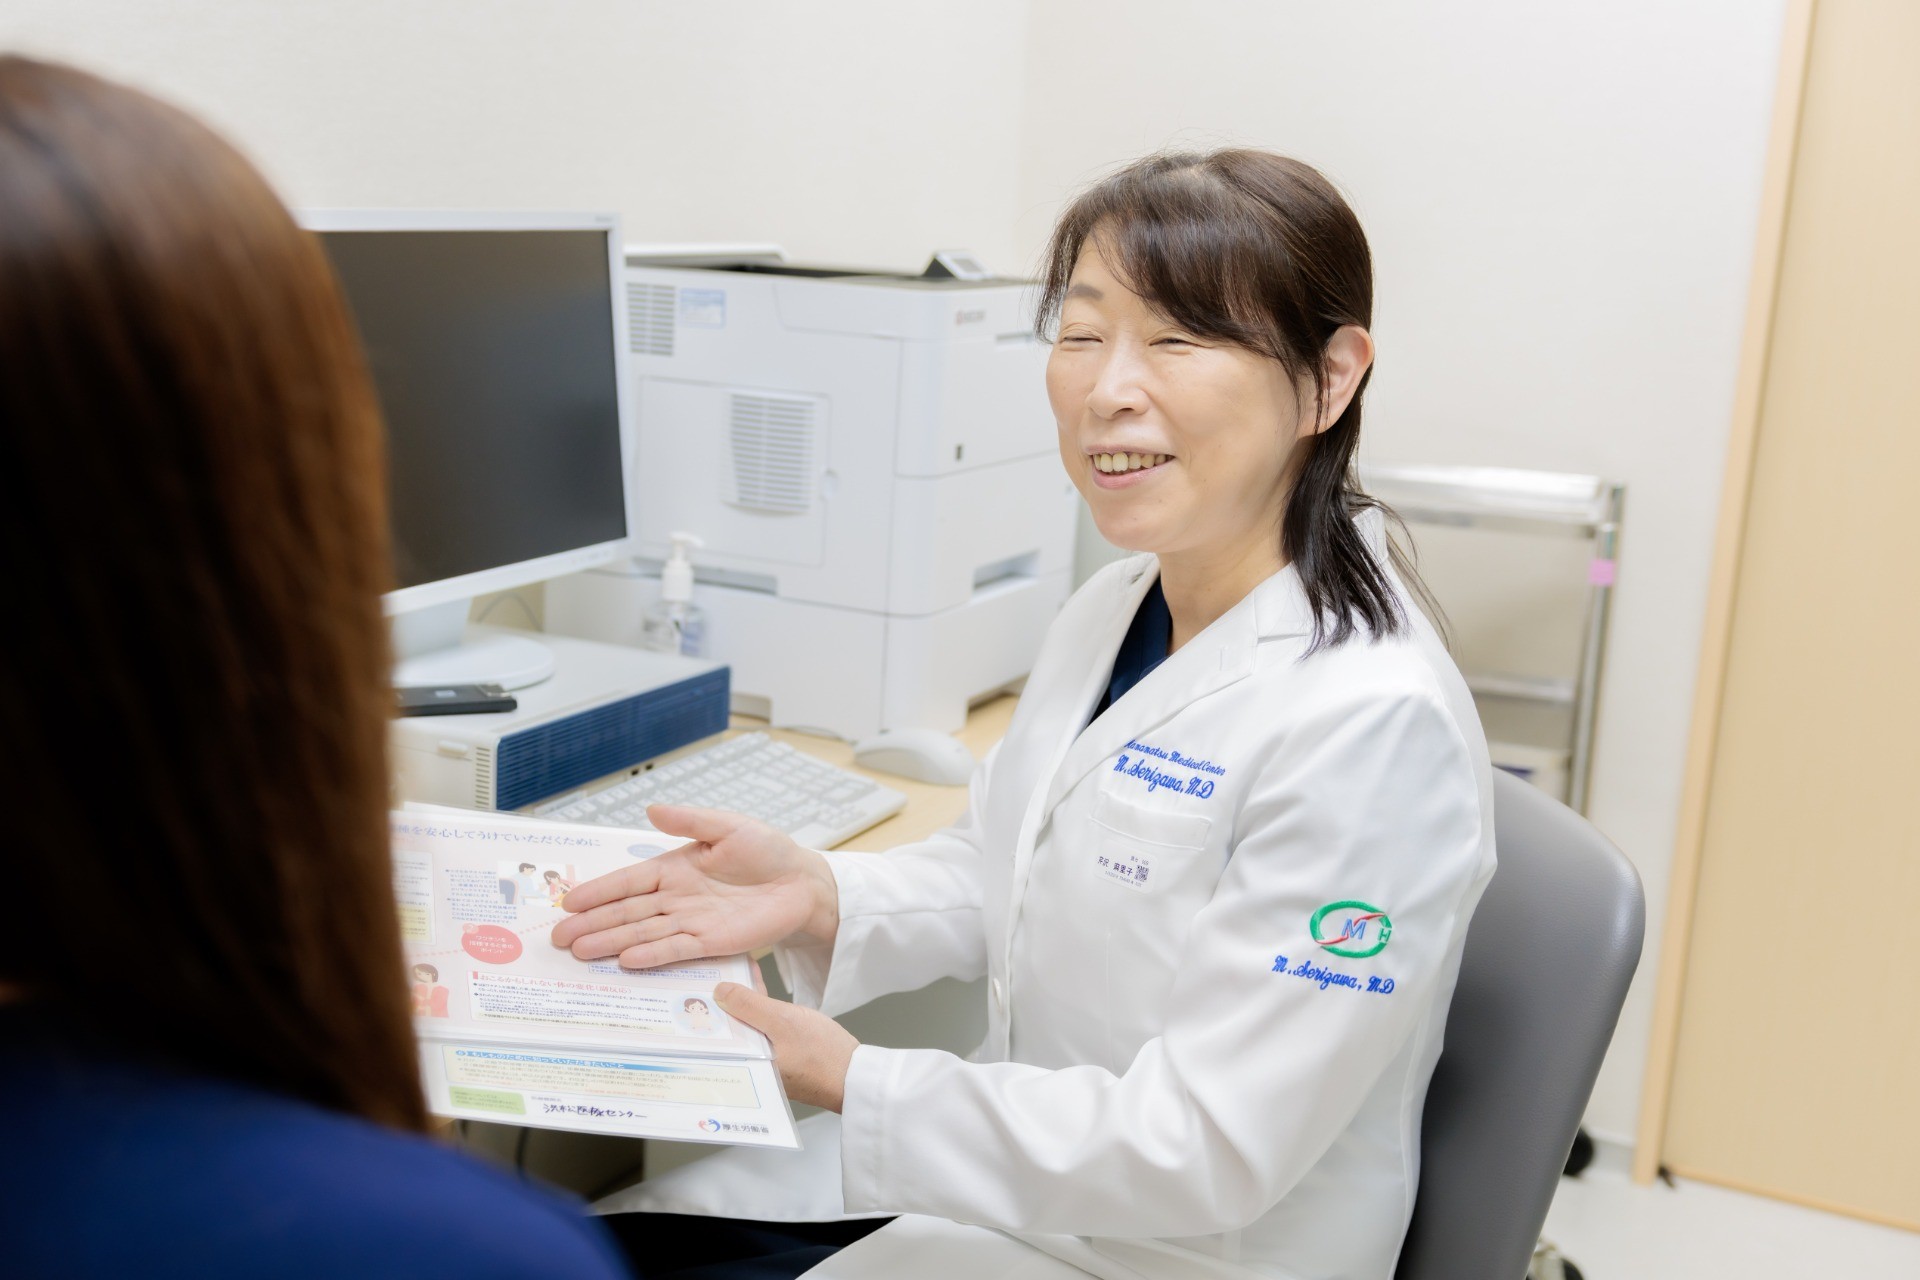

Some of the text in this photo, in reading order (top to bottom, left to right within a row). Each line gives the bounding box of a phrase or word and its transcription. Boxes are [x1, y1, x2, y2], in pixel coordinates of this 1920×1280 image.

[1168, 750, 1205, 770] Medical
[1202, 761, 1226, 776] Center
[389, 823, 601, 847] 種を安心してうけていただくために
[1341, 917, 1392, 942] M H
